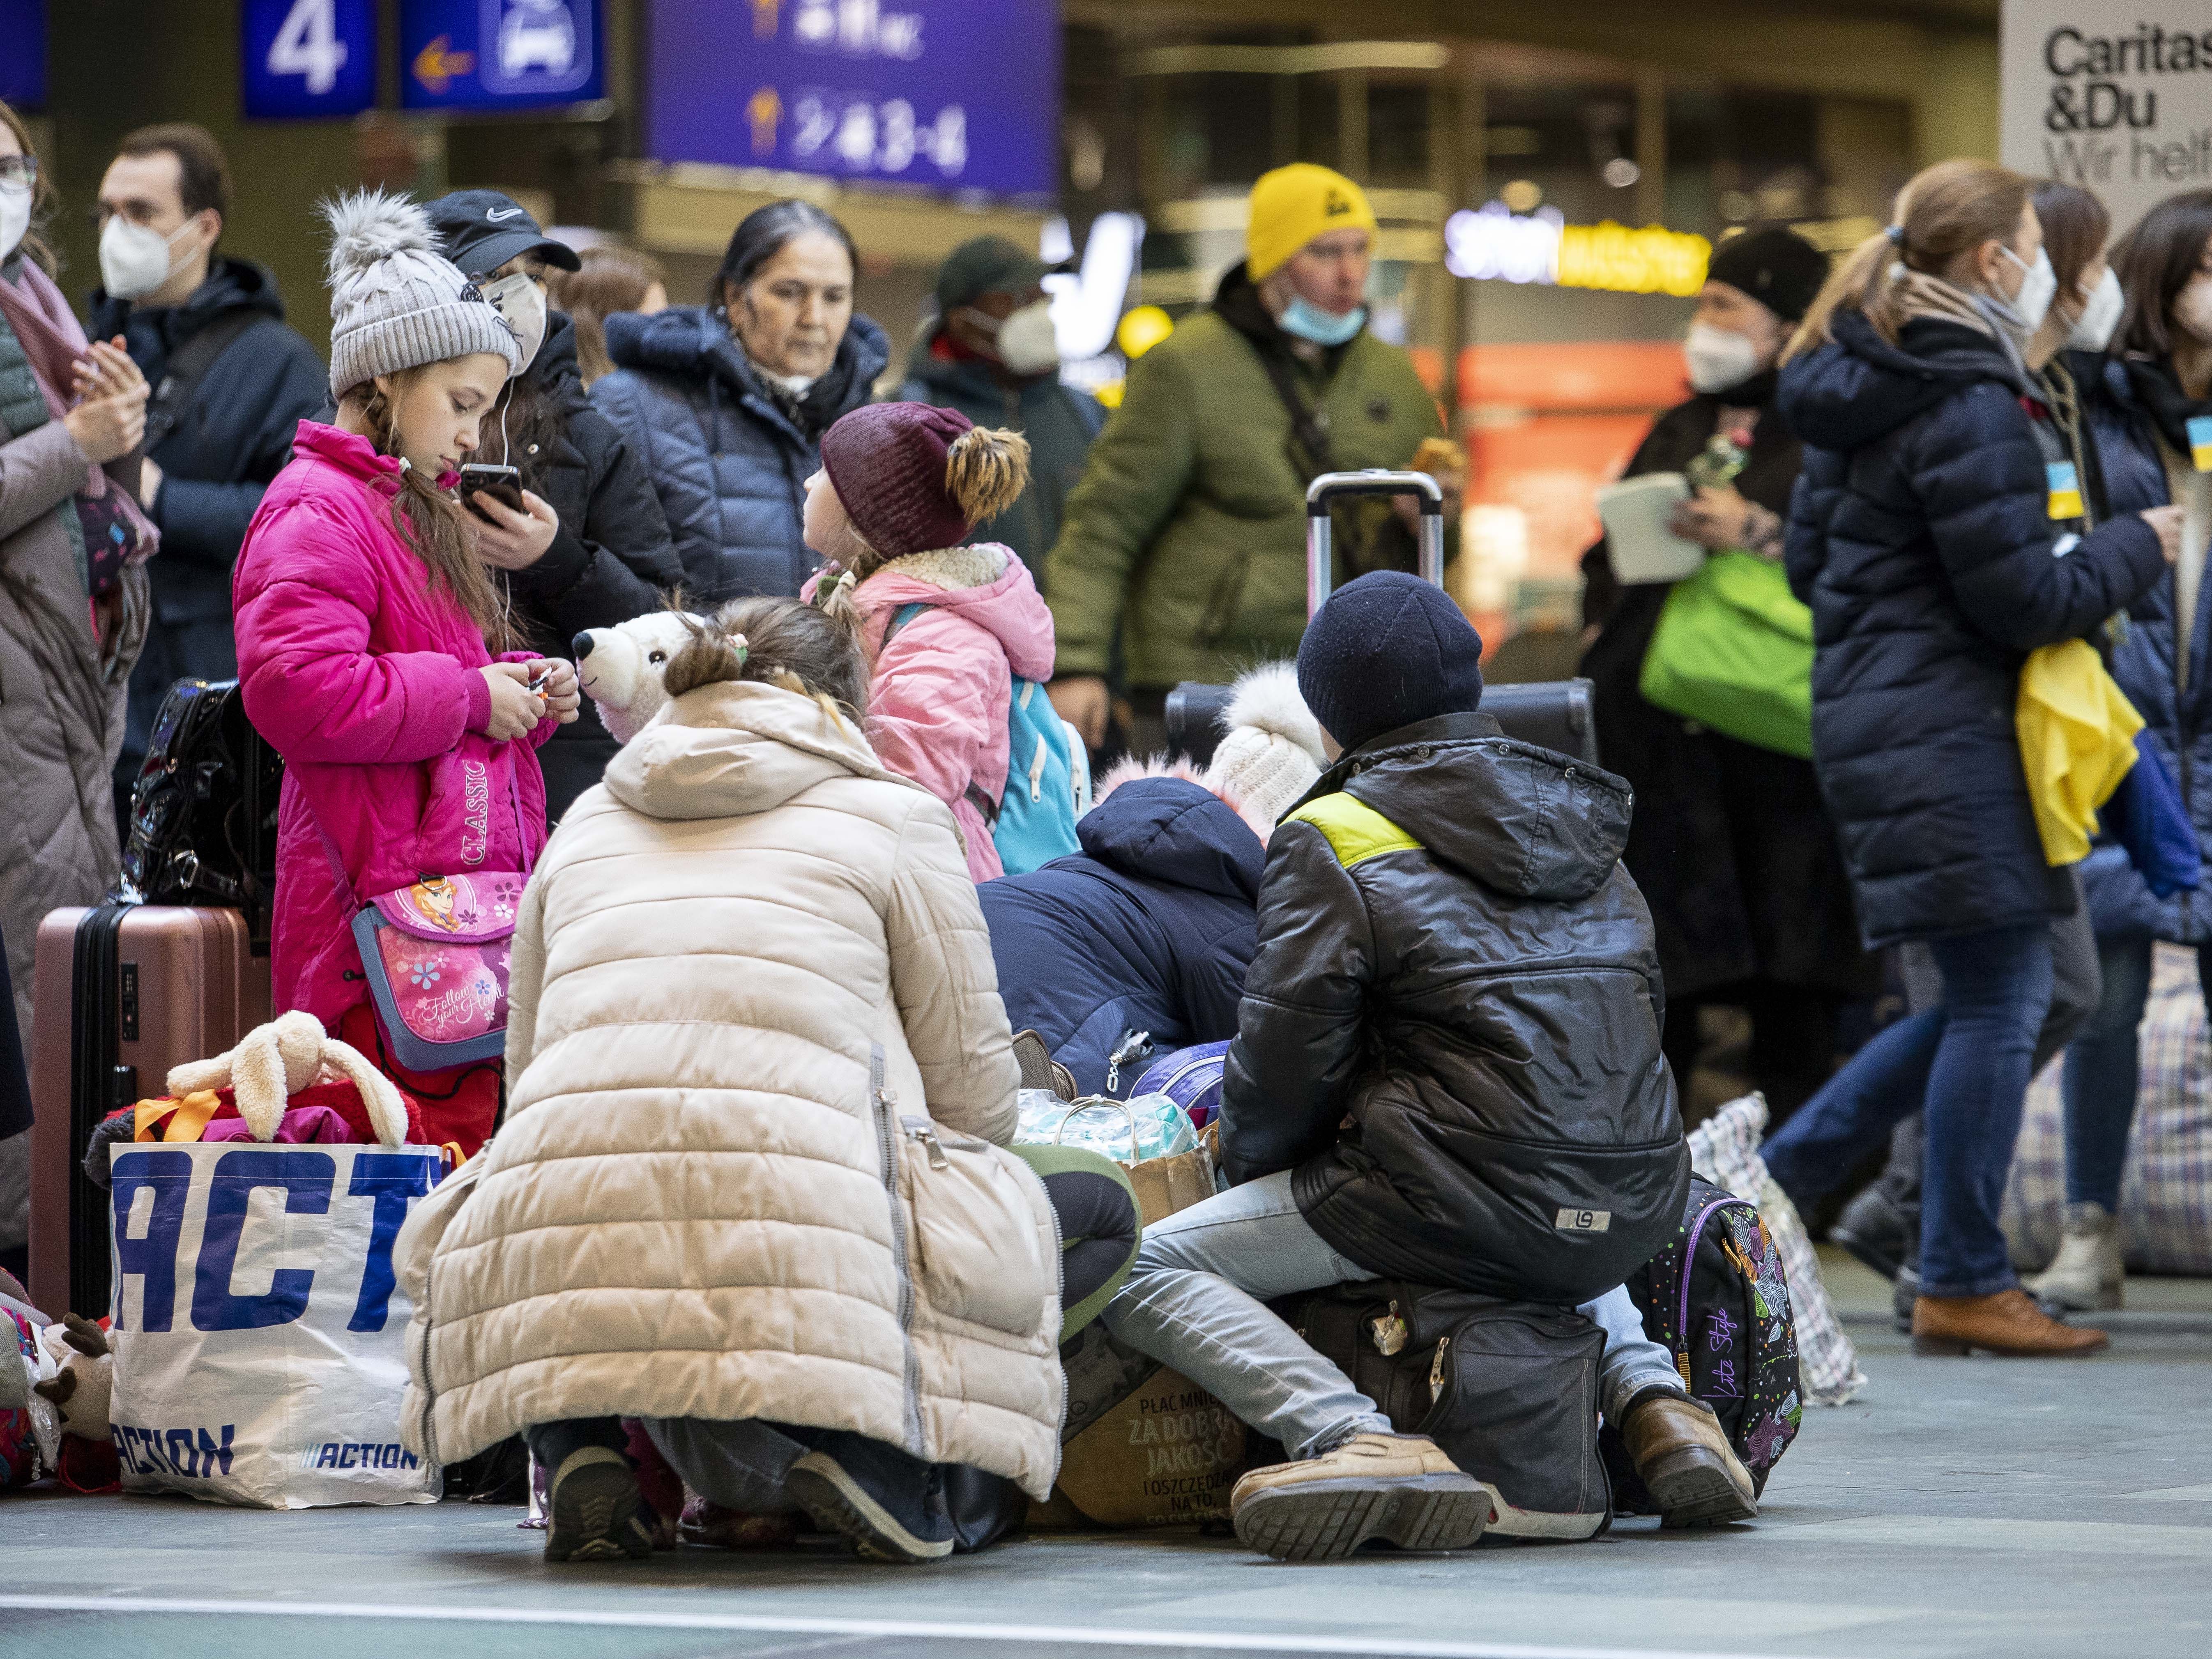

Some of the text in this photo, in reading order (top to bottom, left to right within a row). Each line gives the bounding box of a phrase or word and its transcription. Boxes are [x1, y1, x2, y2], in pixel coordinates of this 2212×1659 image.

[266, 0, 348, 95] 4
[2045, 23, 2212, 77] Caritas
[2045, 82, 2157, 133] &Du
[460, 760, 488, 865] CLASSIC
[422, 985, 470, 1022] Follow
[437, 983, 505, 1029] your Heart
[111, 1150, 449, 1333] ACT
[1701, 1307, 1745, 1398] Kite Style
[1140, 1390, 1222, 1414] PŁAĆ MNIE
[110, 1424, 234, 1478] ACTION
[1127, 1418, 1161, 1445] ZA
[1147, 1432, 1230, 1478] JAKOŚĆ
[317, 1443, 419, 1470] ACTION
[1171, 1496, 1192, 1511] NA
